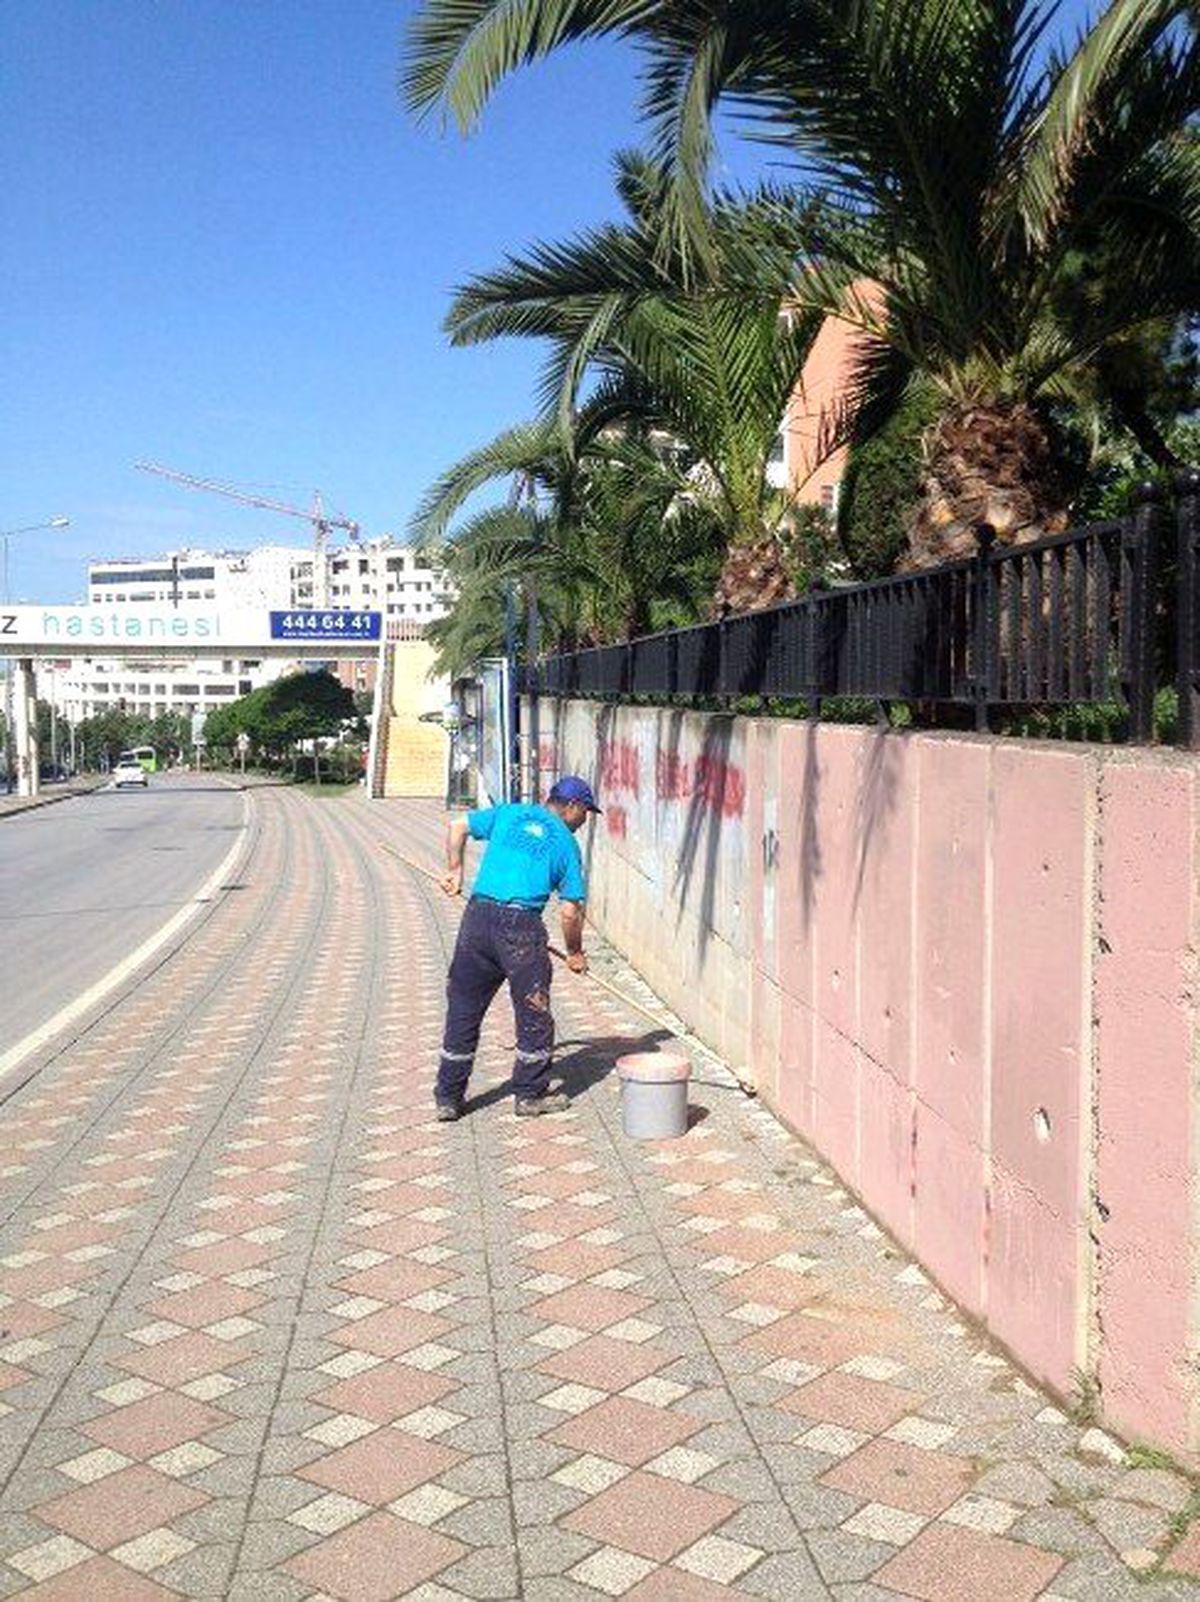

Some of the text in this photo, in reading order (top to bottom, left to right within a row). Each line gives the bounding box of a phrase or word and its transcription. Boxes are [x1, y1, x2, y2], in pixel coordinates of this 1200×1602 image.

[43, 611, 221, 637] hastanesi
[282, 614, 371, 630] 444 64 41
